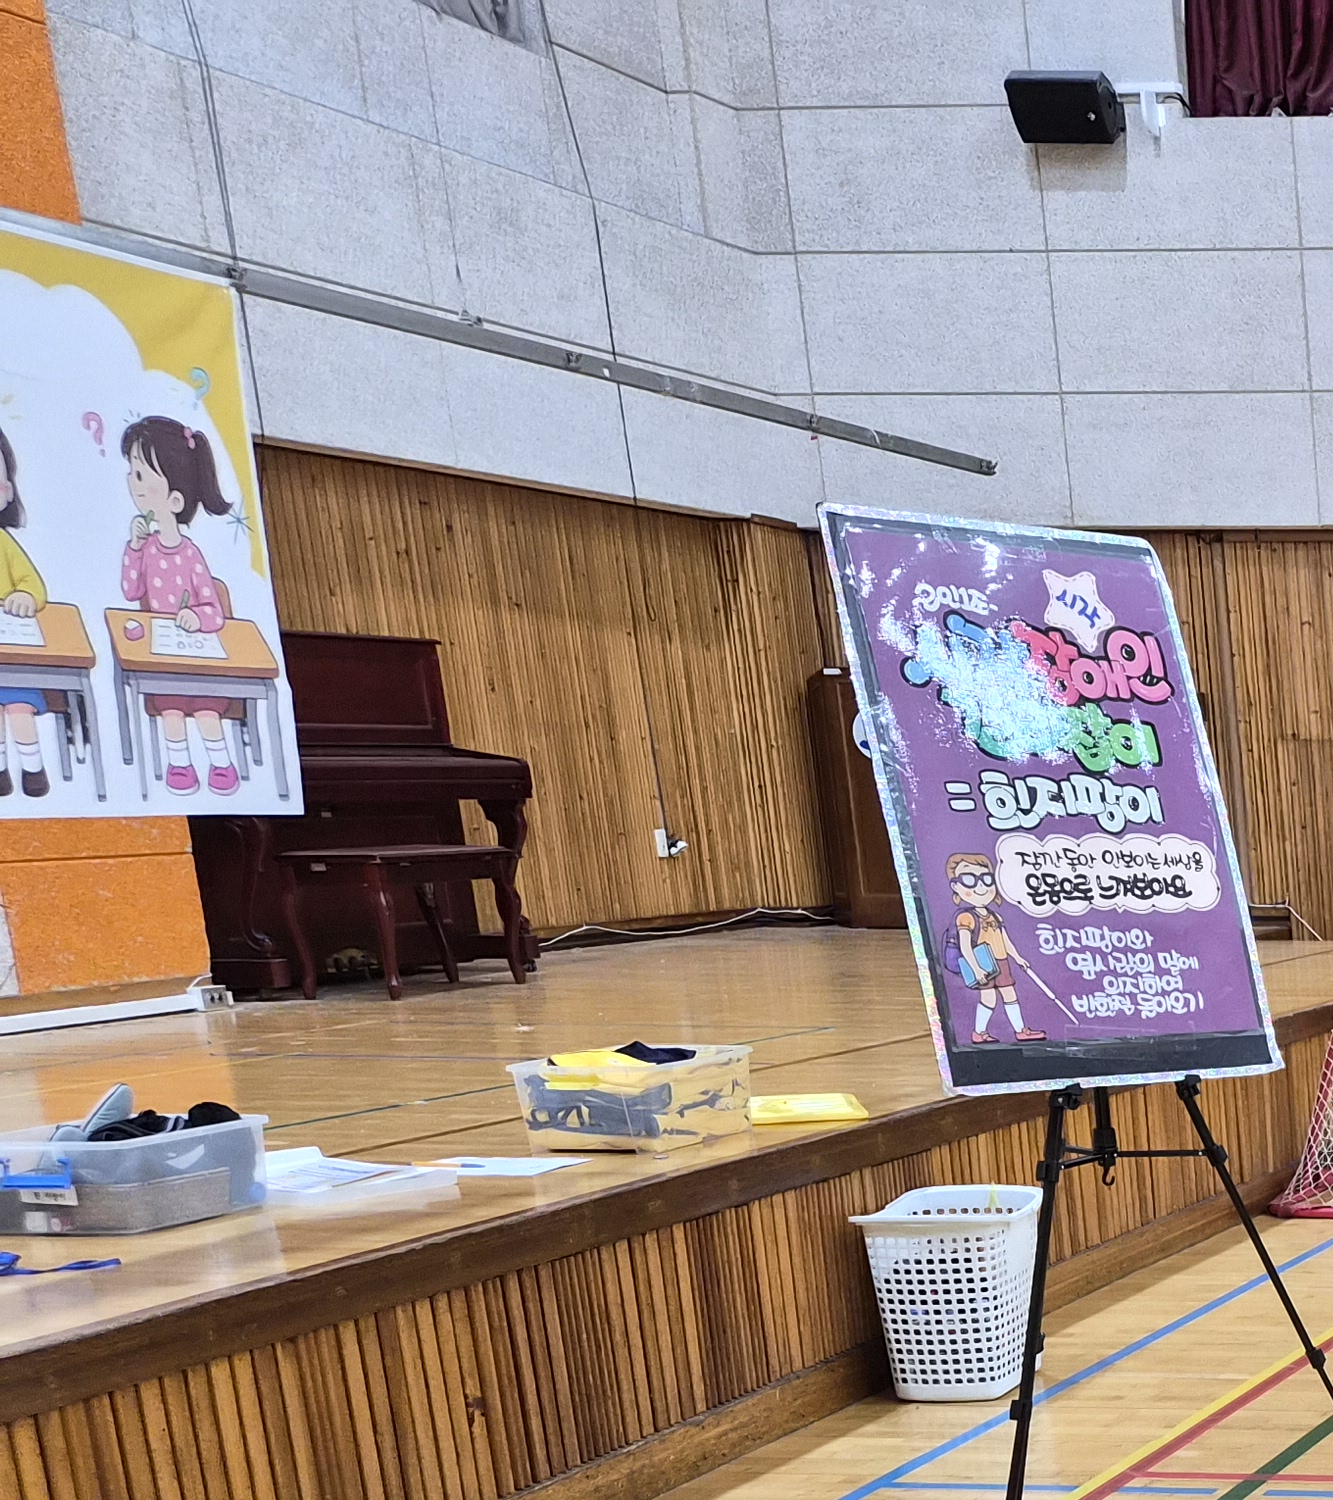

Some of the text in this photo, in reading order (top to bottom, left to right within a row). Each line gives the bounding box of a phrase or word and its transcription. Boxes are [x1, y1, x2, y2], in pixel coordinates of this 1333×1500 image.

[1056, 589, 1102, 629] 시각
[979, 770, 1165, 833] 흰지팡이
[1025, 873, 1094, 906] 온몸으로
[1035, 923, 1154, 955] 흰지팡이와
[1157, 949, 1199, 975] 말에
[1103, 974, 1183, 994] 의지하여
[1137, 991, 1204, 1019] 돌아오기
